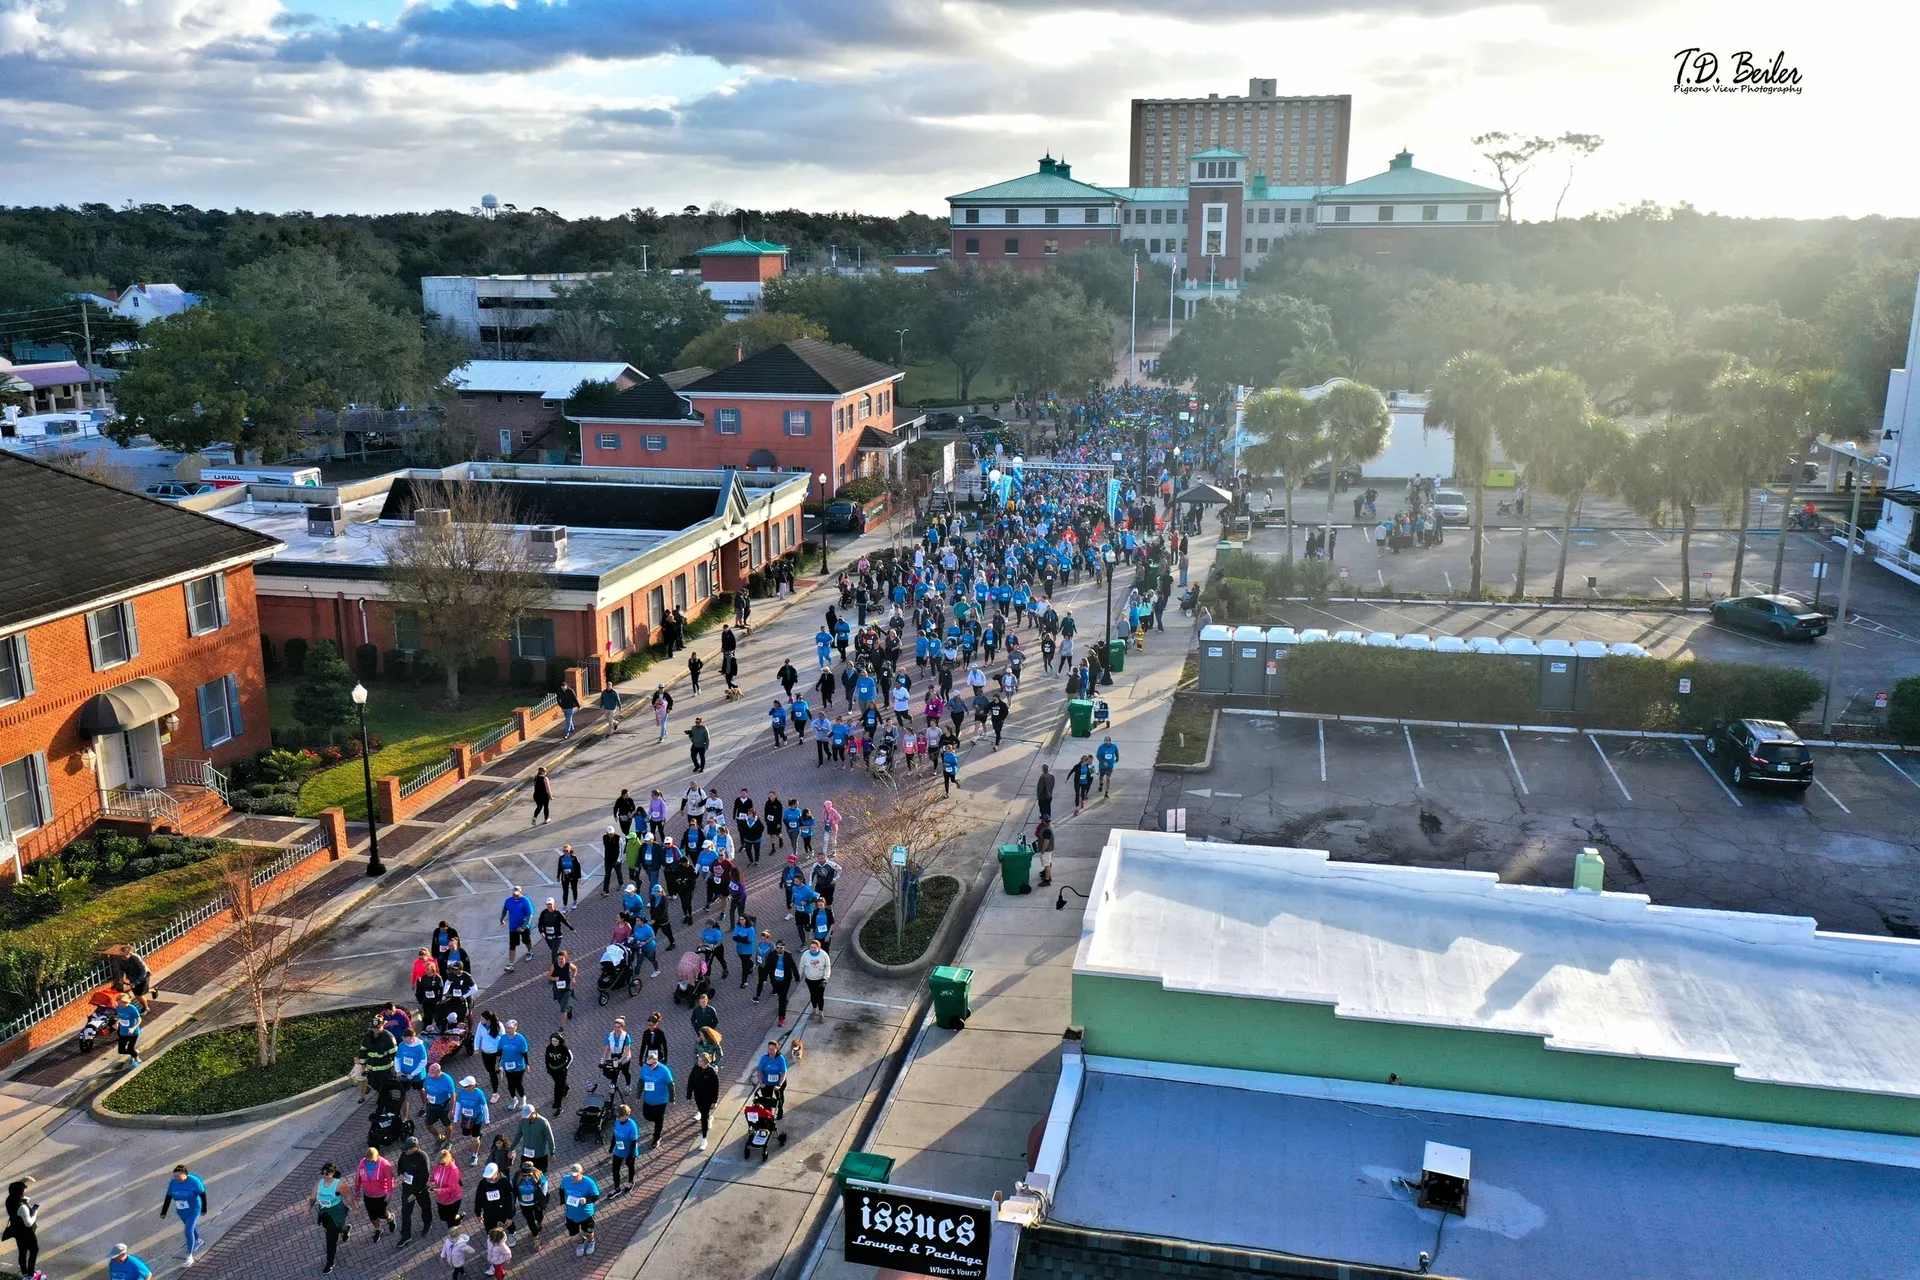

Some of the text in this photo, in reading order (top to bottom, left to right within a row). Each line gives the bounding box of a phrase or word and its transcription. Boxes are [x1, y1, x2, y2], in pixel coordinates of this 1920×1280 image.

[860, 1196, 976, 1247] issues
[852, 1235, 983, 1266] Lounge & Package
[929, 1266, 981, 1277] What's Yours?
